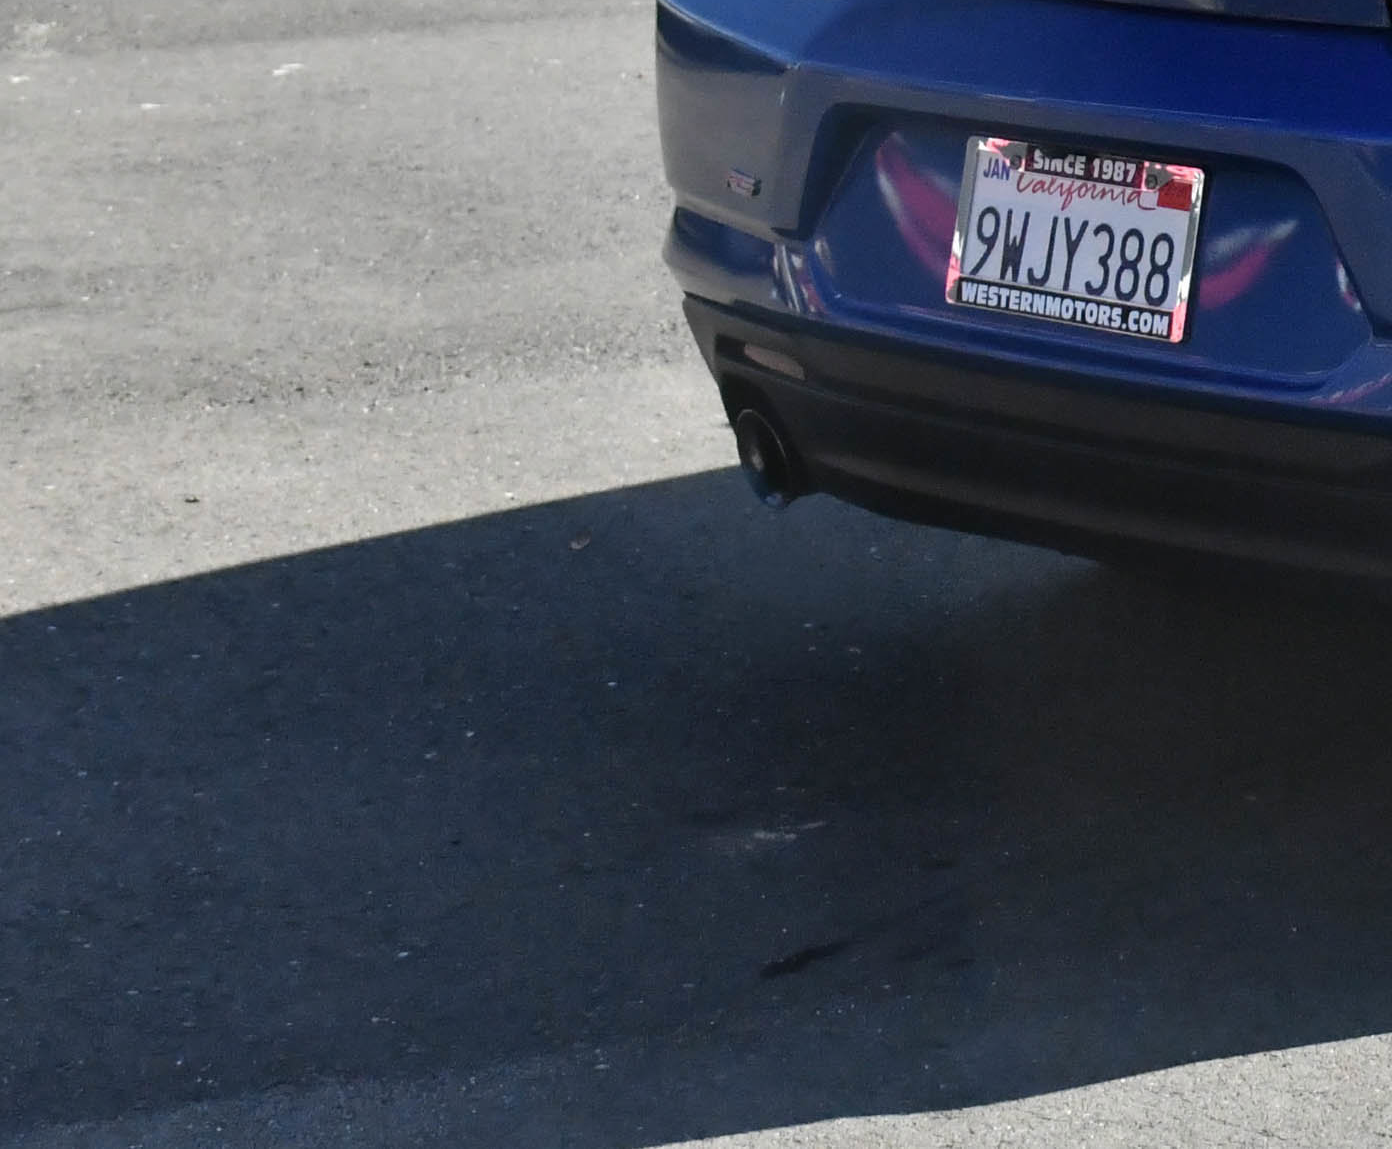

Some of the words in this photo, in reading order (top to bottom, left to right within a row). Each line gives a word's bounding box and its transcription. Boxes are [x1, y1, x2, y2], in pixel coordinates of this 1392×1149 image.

[983, 158, 1011, 181] JAN
[1093, 157, 1137, 183] 1987
[1016, 173, 1157, 212] California
[968, 205, 1176, 307] 9WJY388
[961, 281, 1170, 337] WESTERNMOTORS.COM
